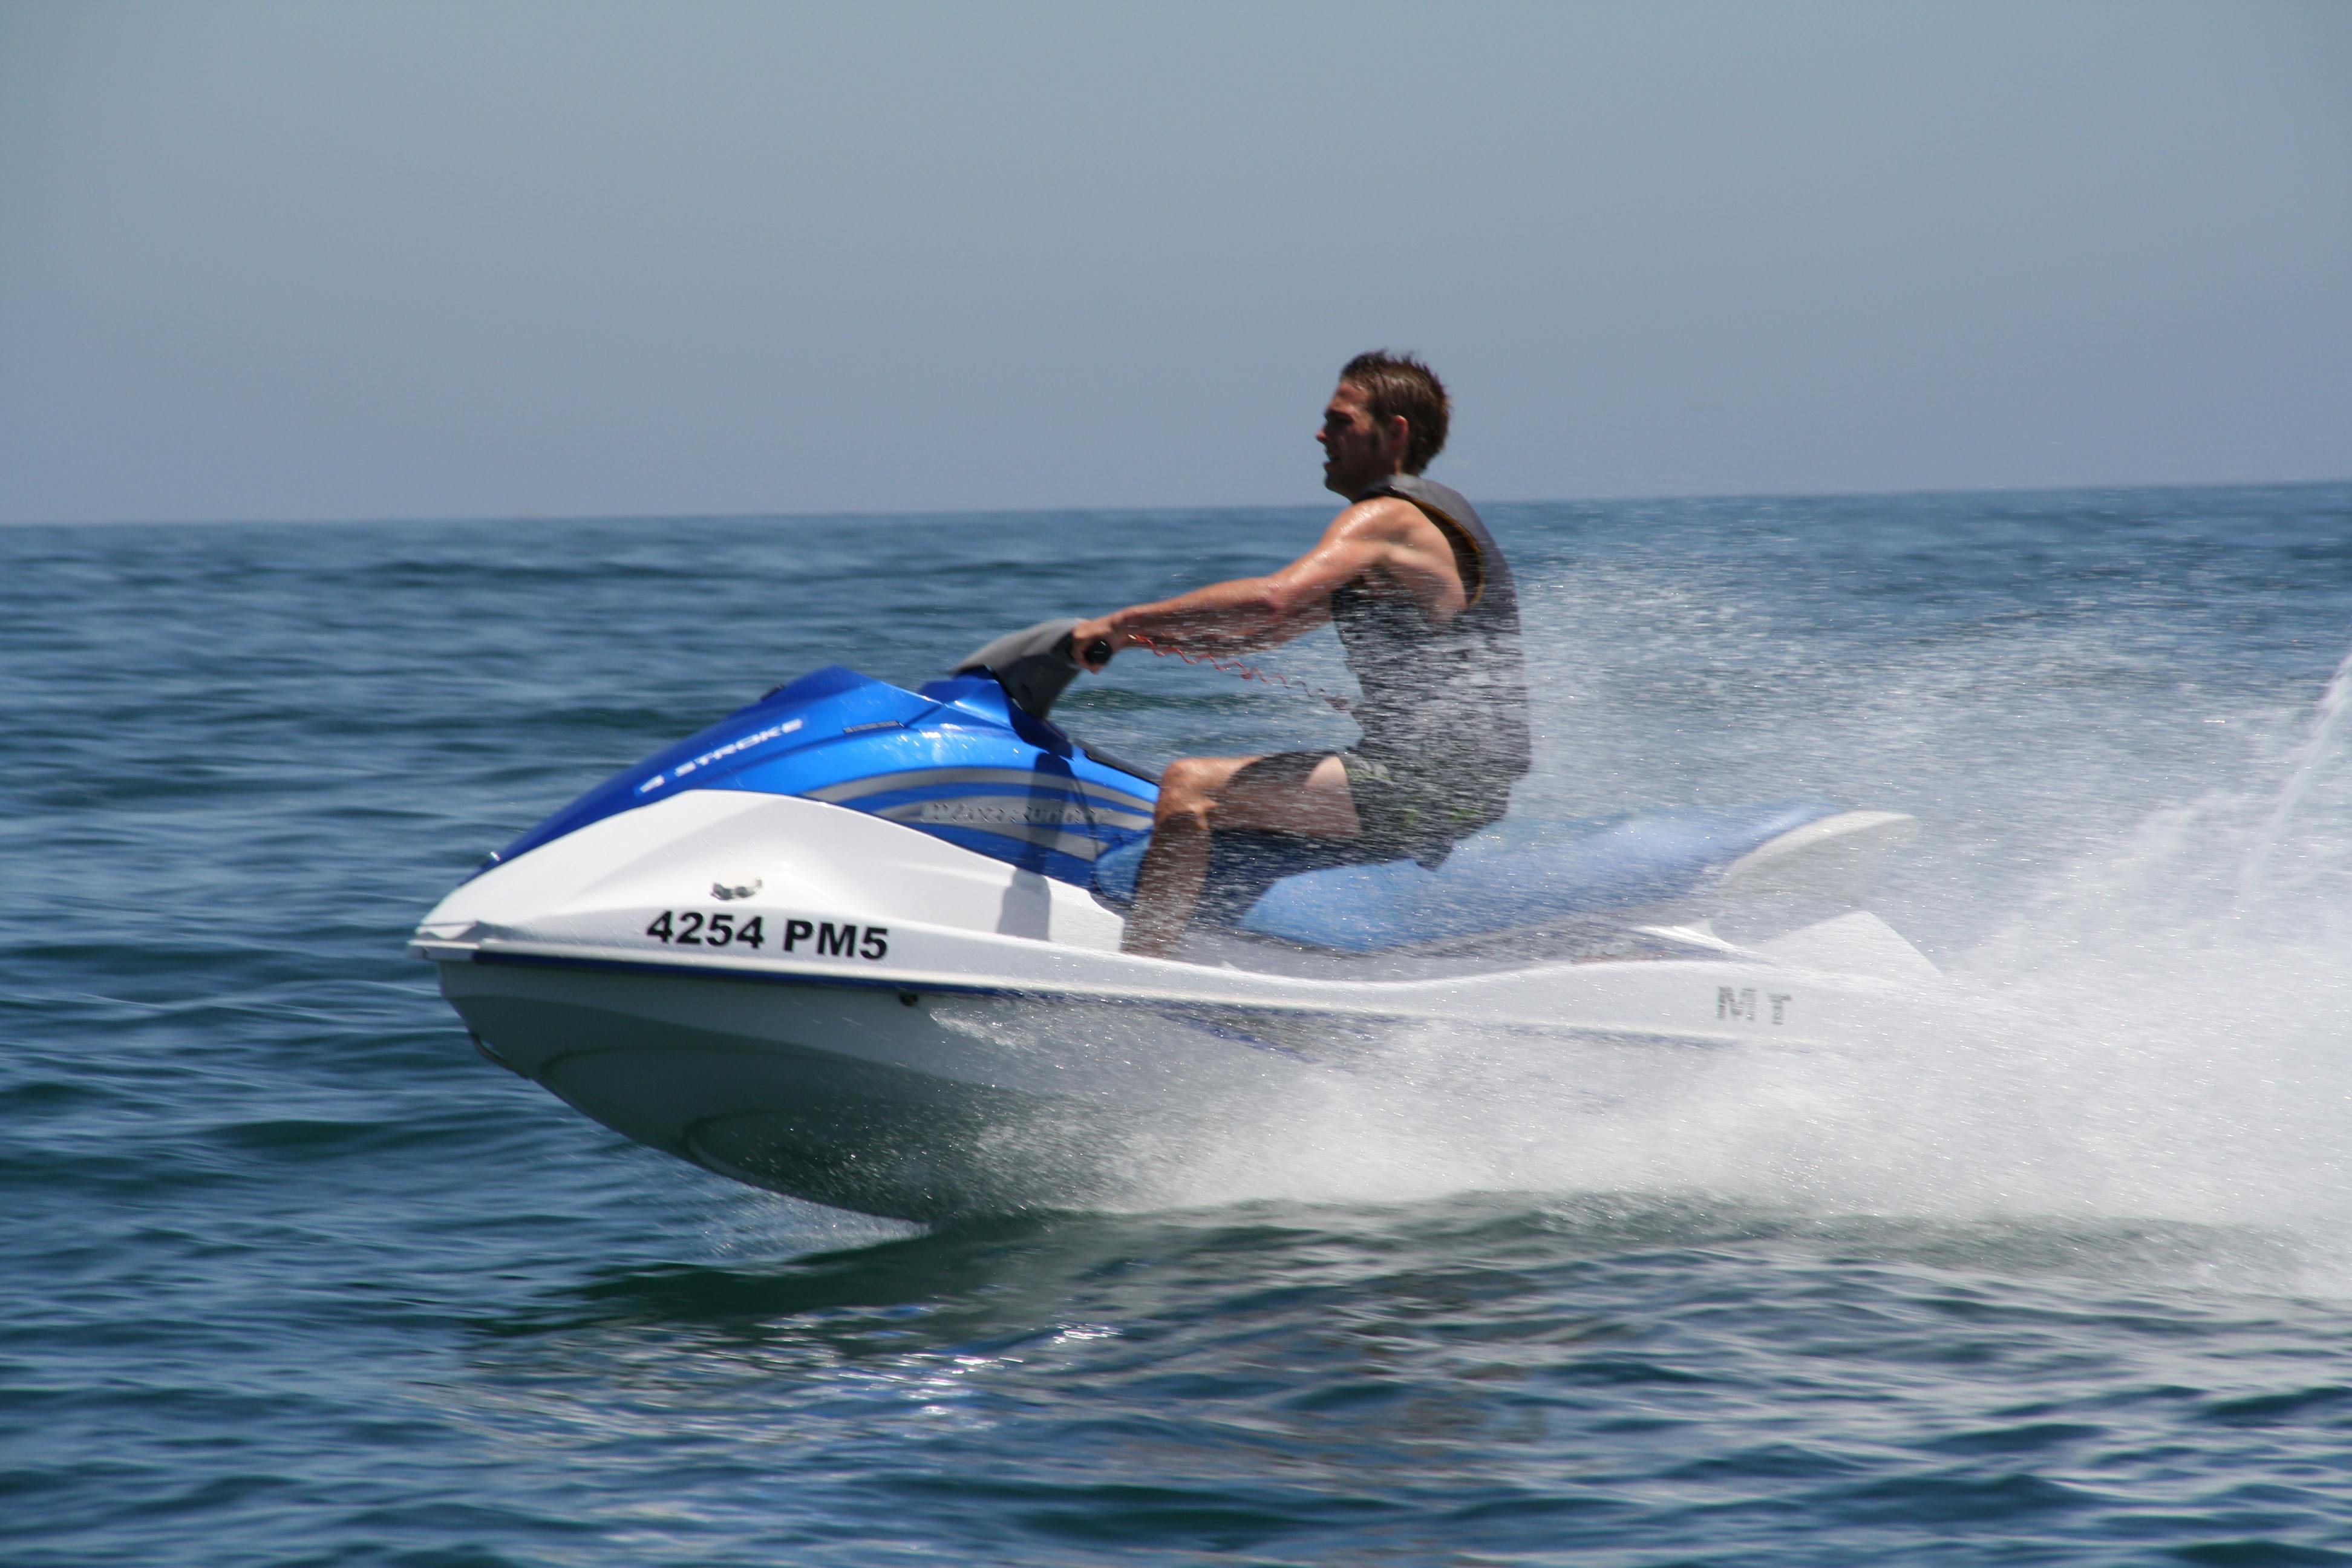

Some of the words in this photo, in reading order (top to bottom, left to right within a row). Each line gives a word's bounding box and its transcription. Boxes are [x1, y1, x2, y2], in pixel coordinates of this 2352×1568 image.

[674, 718, 803, 777] STROKE
[646, 910, 765, 949] 4254
[783, 918, 888, 960] PM5
